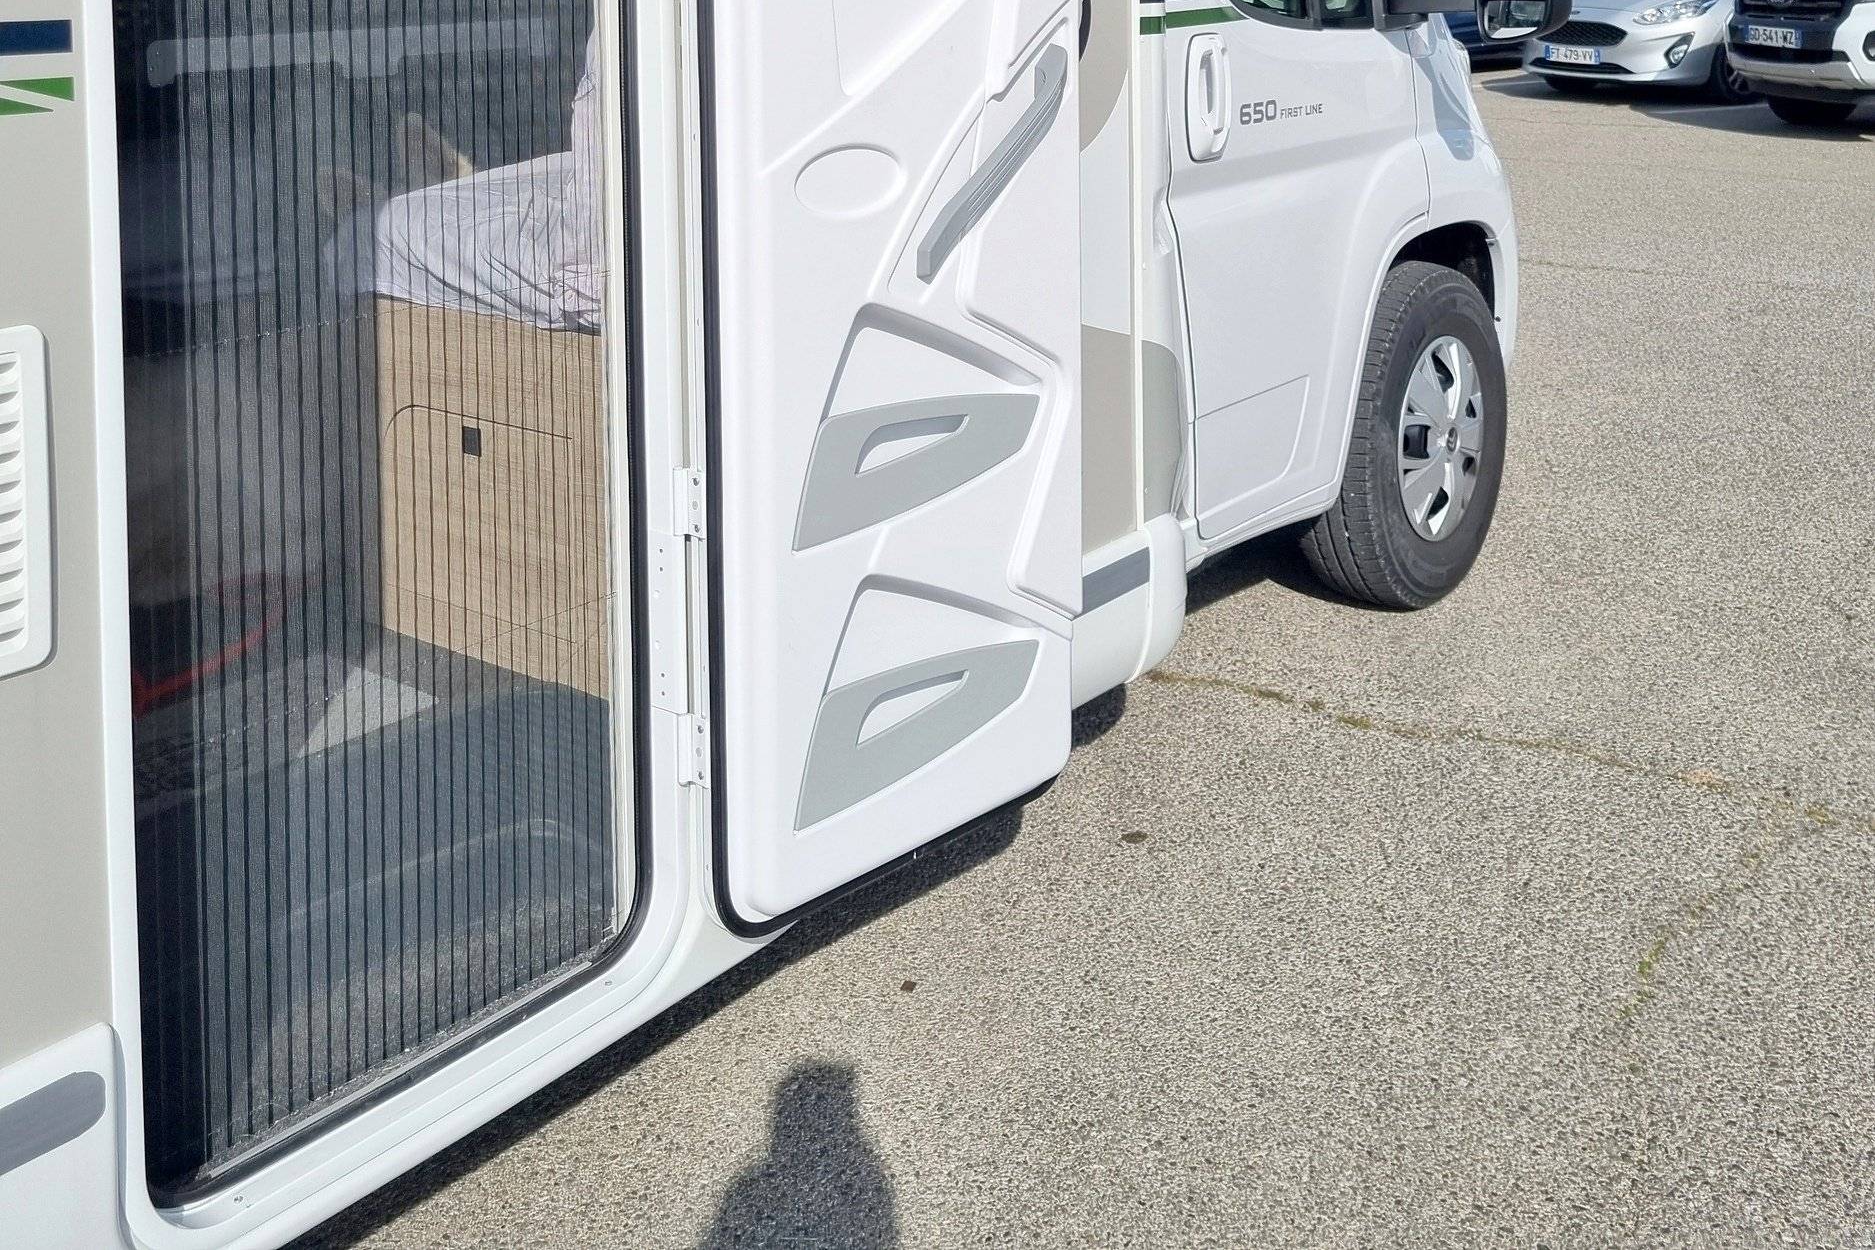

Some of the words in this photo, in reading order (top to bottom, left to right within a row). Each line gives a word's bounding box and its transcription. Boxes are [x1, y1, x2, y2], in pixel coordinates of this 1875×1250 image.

[1240, 99, 1277, 125] 650
[1280, 106, 1304, 119] FIRST
[1305, 103, 1323, 116] LINE
